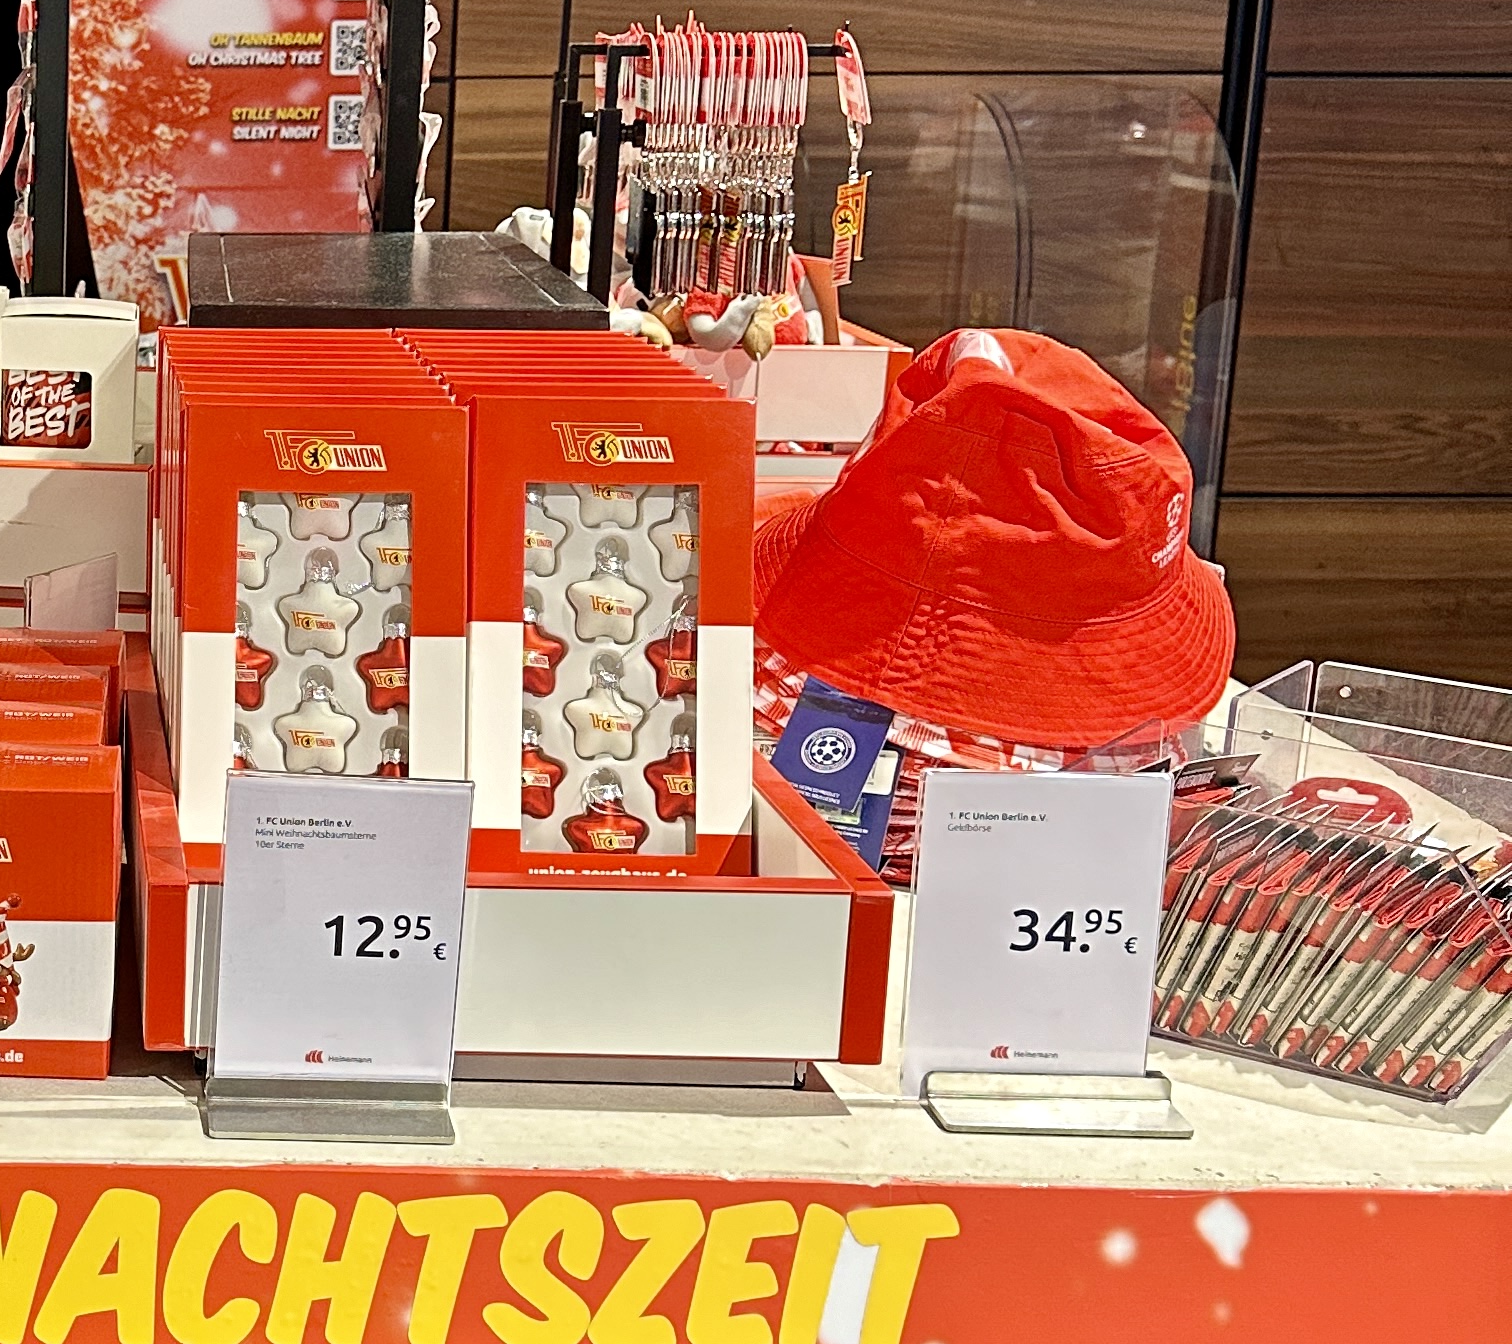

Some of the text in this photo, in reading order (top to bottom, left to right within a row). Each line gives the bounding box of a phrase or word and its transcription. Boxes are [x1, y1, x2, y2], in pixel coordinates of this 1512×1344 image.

[210, 33, 324, 46] OH TANNENBAUM
[188, 51, 323, 66] OH CHRISTMAS TREE
[231, 107, 321, 121] STILLE NACHT
[233, 126, 321, 140] SILENT NIGHT
[12, 384, 76, 406] OF THE
[8, 401, 90, 440] BEST
[621, 438, 672, 462] UNION
[334, 446, 384, 469] UNION
[266, 817, 335, 827] FC Union Berlin
[959, 812, 1028, 821] FC Union Berlin
[255, 828, 274, 837] Mini
[255, 841, 304, 850] 10er Sterne
[325, 914, 431, 959] 12.95
[1009, 908, 1123, 953] 34.95
[1014, 1050, 1058, 1059] Heinemann
